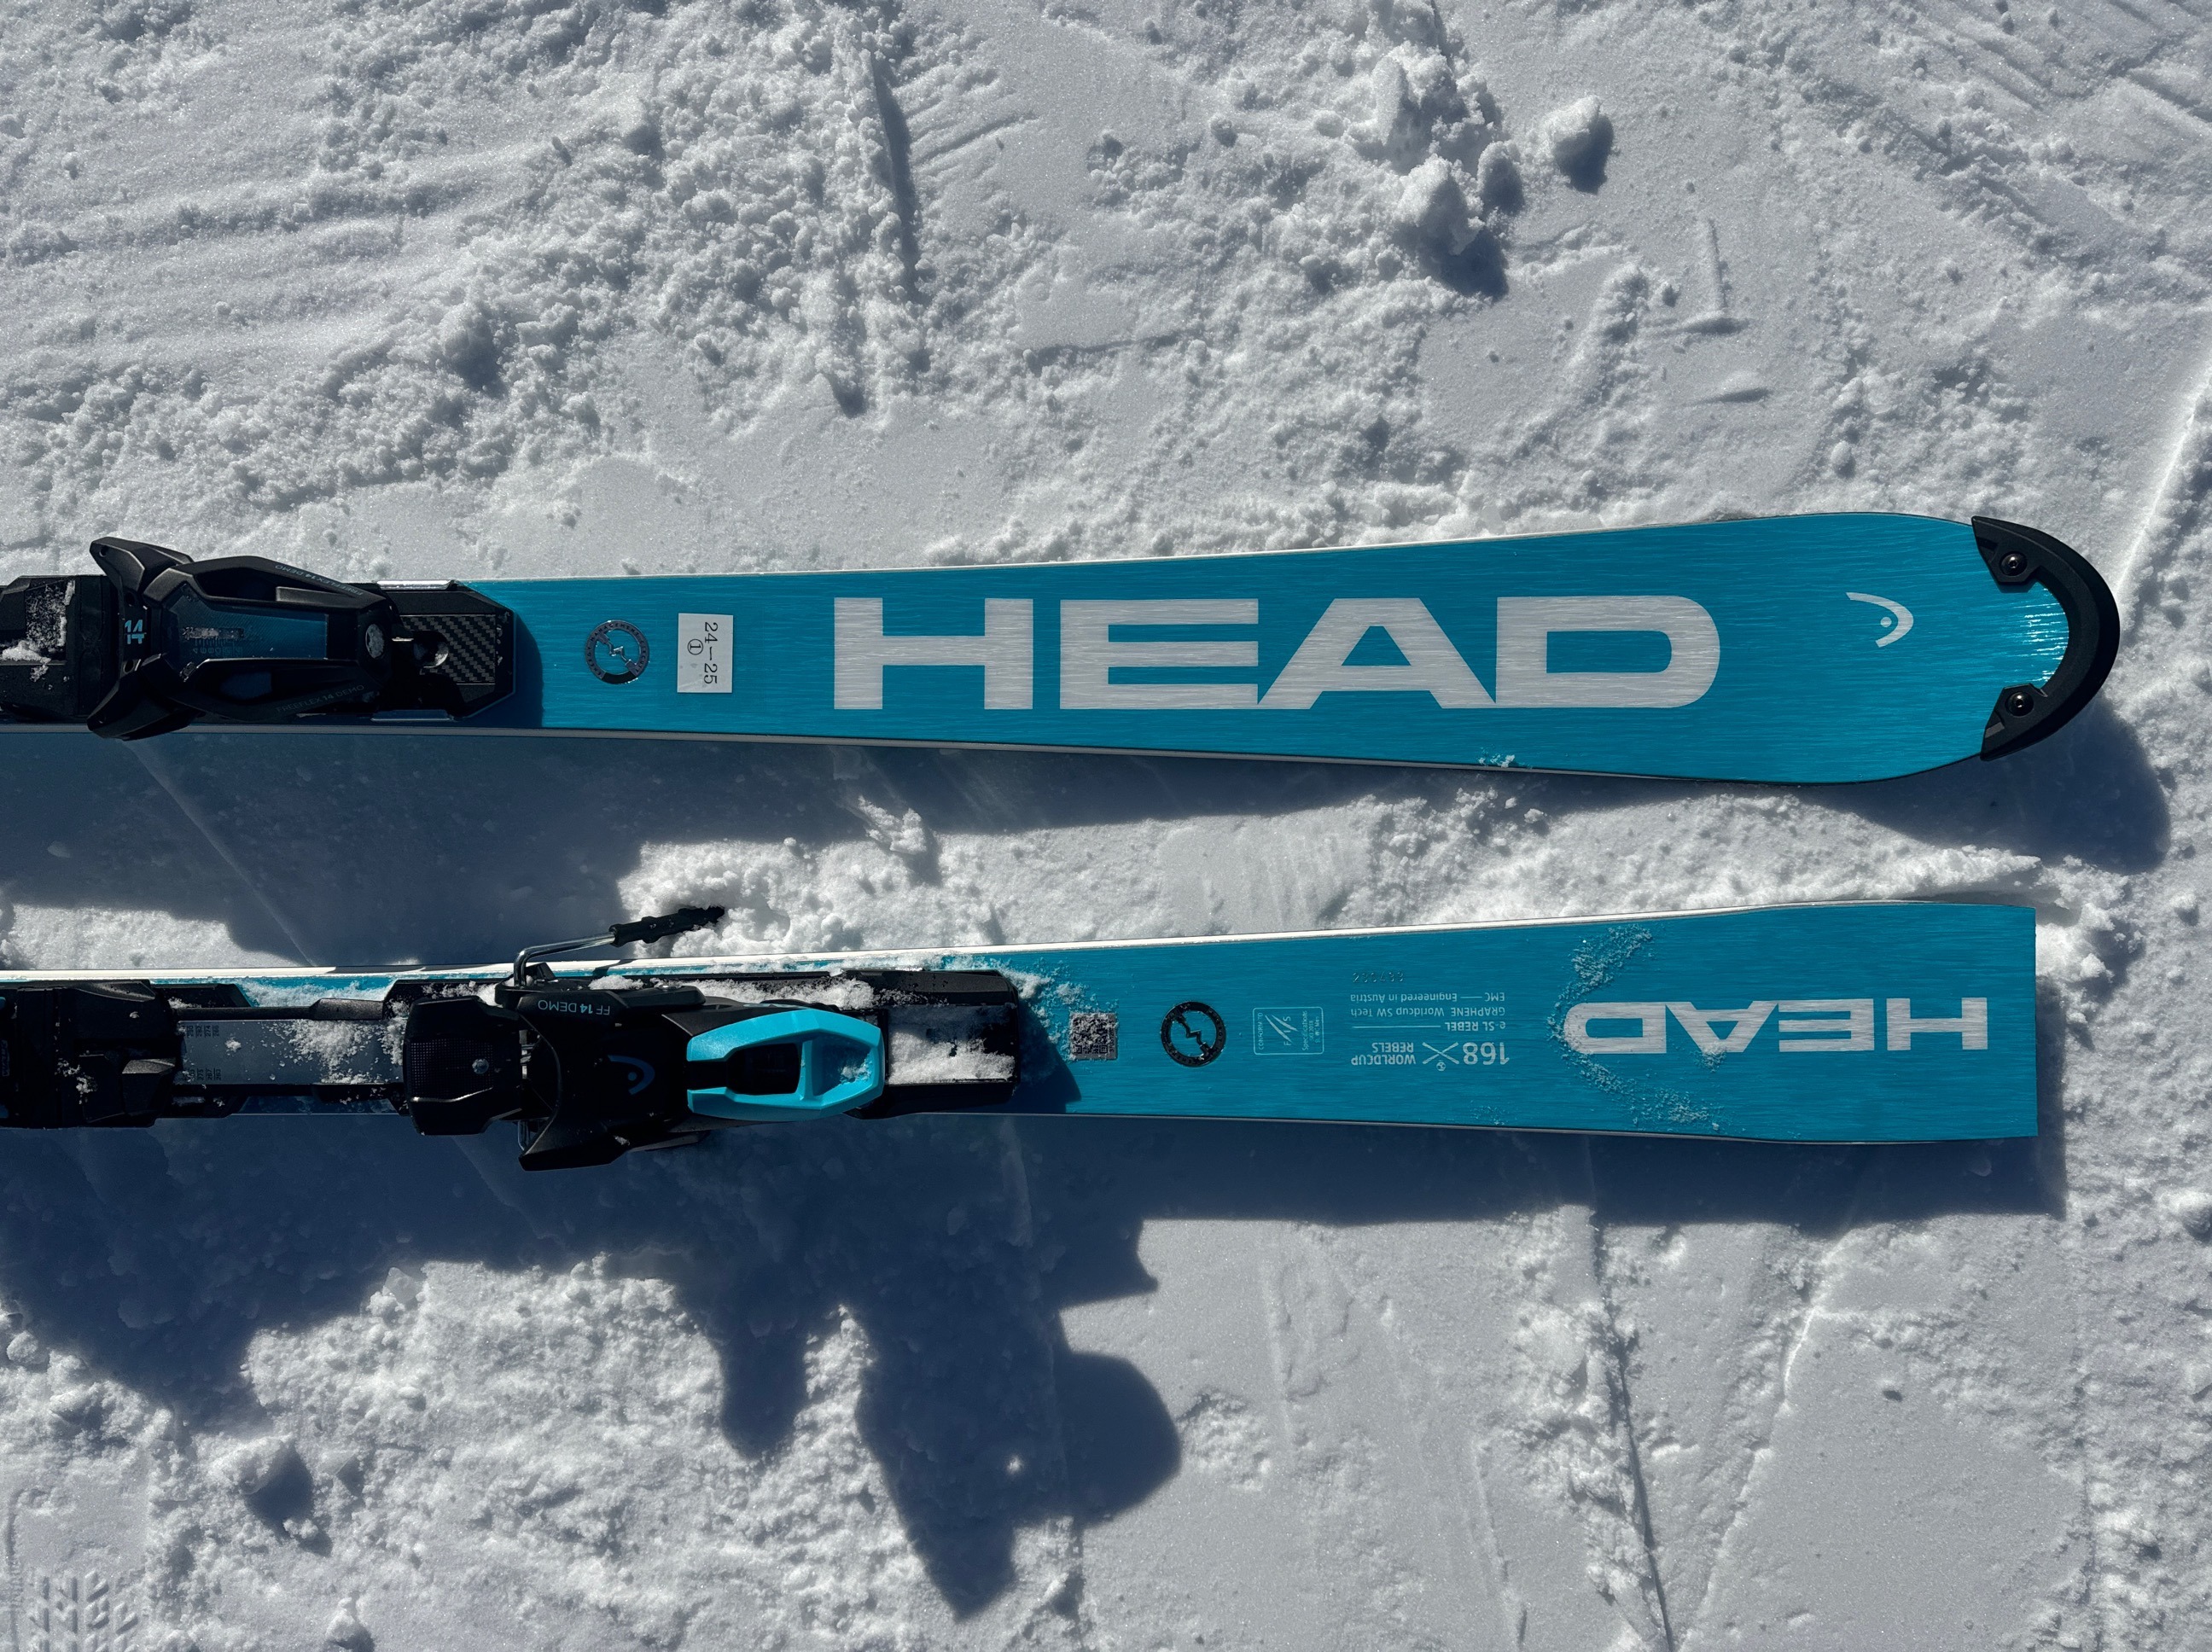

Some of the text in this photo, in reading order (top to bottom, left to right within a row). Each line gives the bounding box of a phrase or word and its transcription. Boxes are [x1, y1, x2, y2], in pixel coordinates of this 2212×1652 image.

[275, 564, 304, 576] DEMO
[124, 619, 147, 645] 14
[832, 593, 1721, 712] HEAD
[323, 692, 335, 701] 14
[1350, 992, 1505, 1003] EMC Engineered in Austria
[537, 998, 611, 1015] FF 14 DEMO
[1350, 1006, 1505, 1018] GRAPHENE Worldcup SW Tech
[1444, 1021, 1506, 1032] e-SL REBEL
[1565, 997, 1988, 1055] HEAD
[1371, 1041, 1414, 1054] REBELS
[1462, 1041, 1511, 1066] 168
[1350, 1053, 1417, 1066] WORLDCUP
